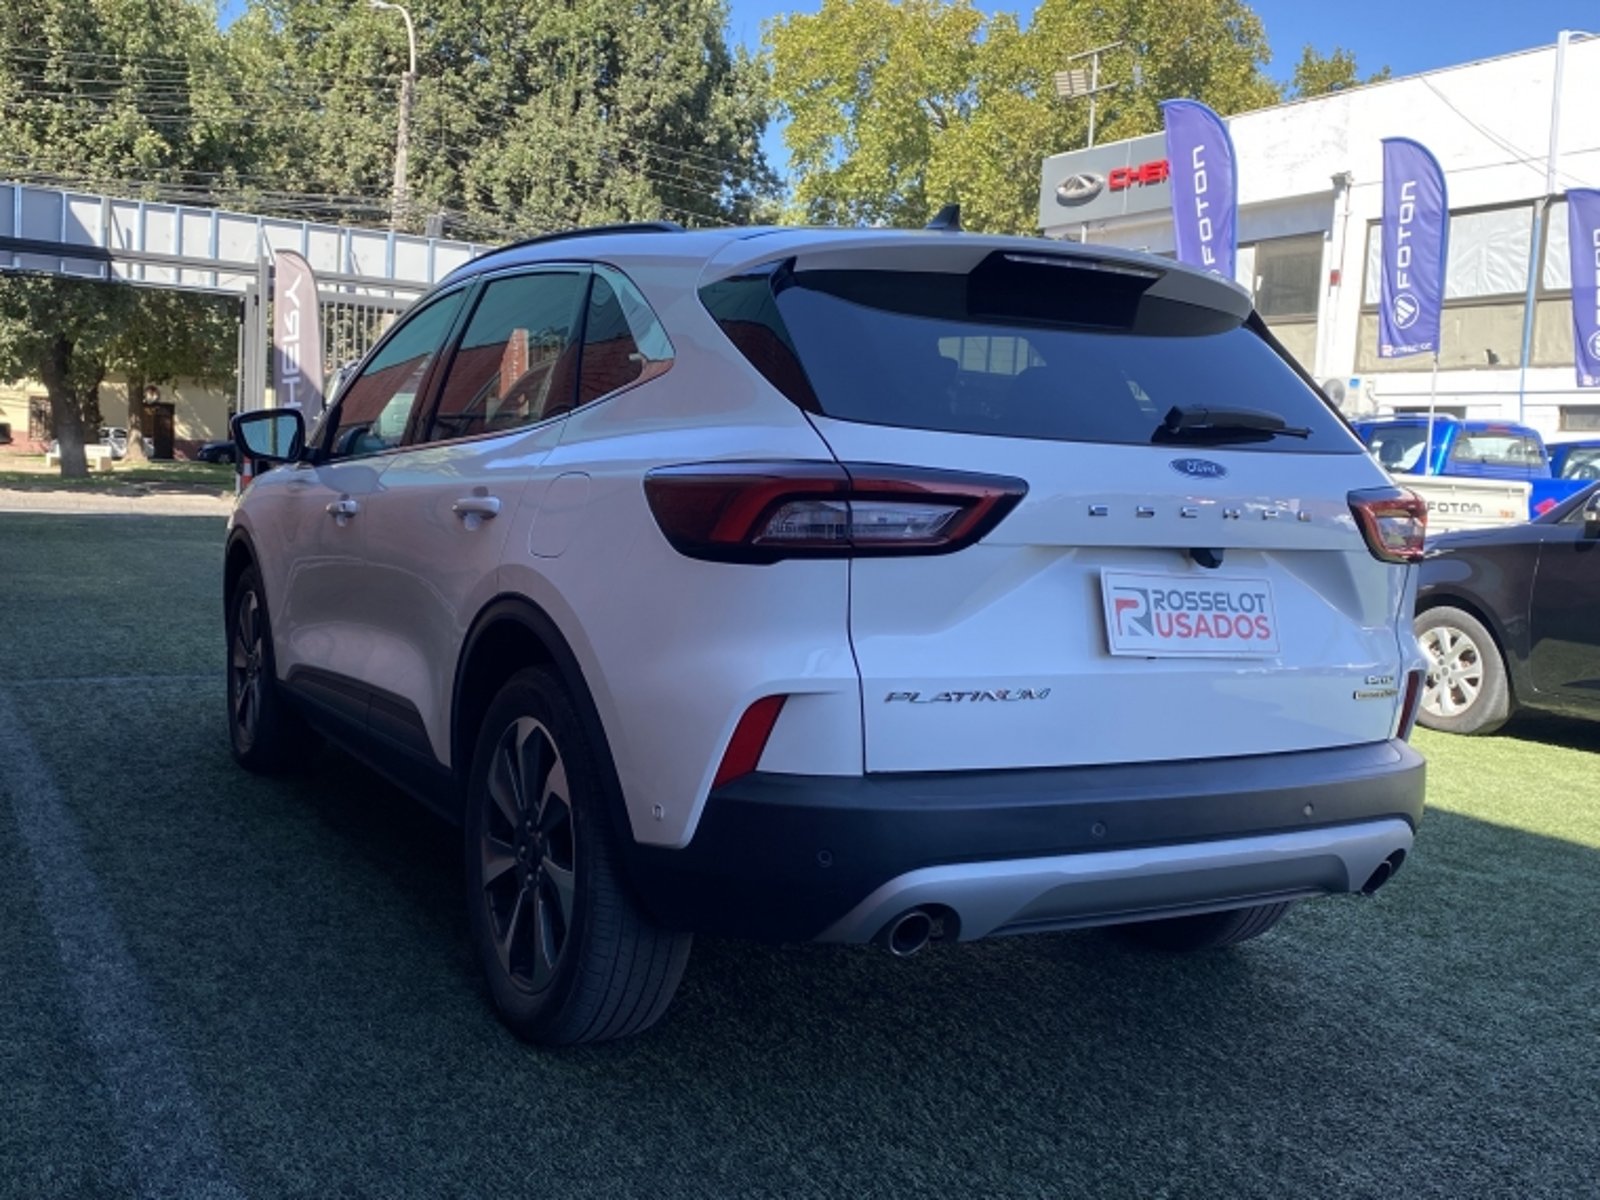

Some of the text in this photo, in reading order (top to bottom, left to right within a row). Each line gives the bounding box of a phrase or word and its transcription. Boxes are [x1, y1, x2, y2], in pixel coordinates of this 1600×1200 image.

[1151, 589, 1266, 613] ROSSELOT
[1155, 613, 1272, 640] USADOS
[884, 688, 1052, 703] PLATINUM
